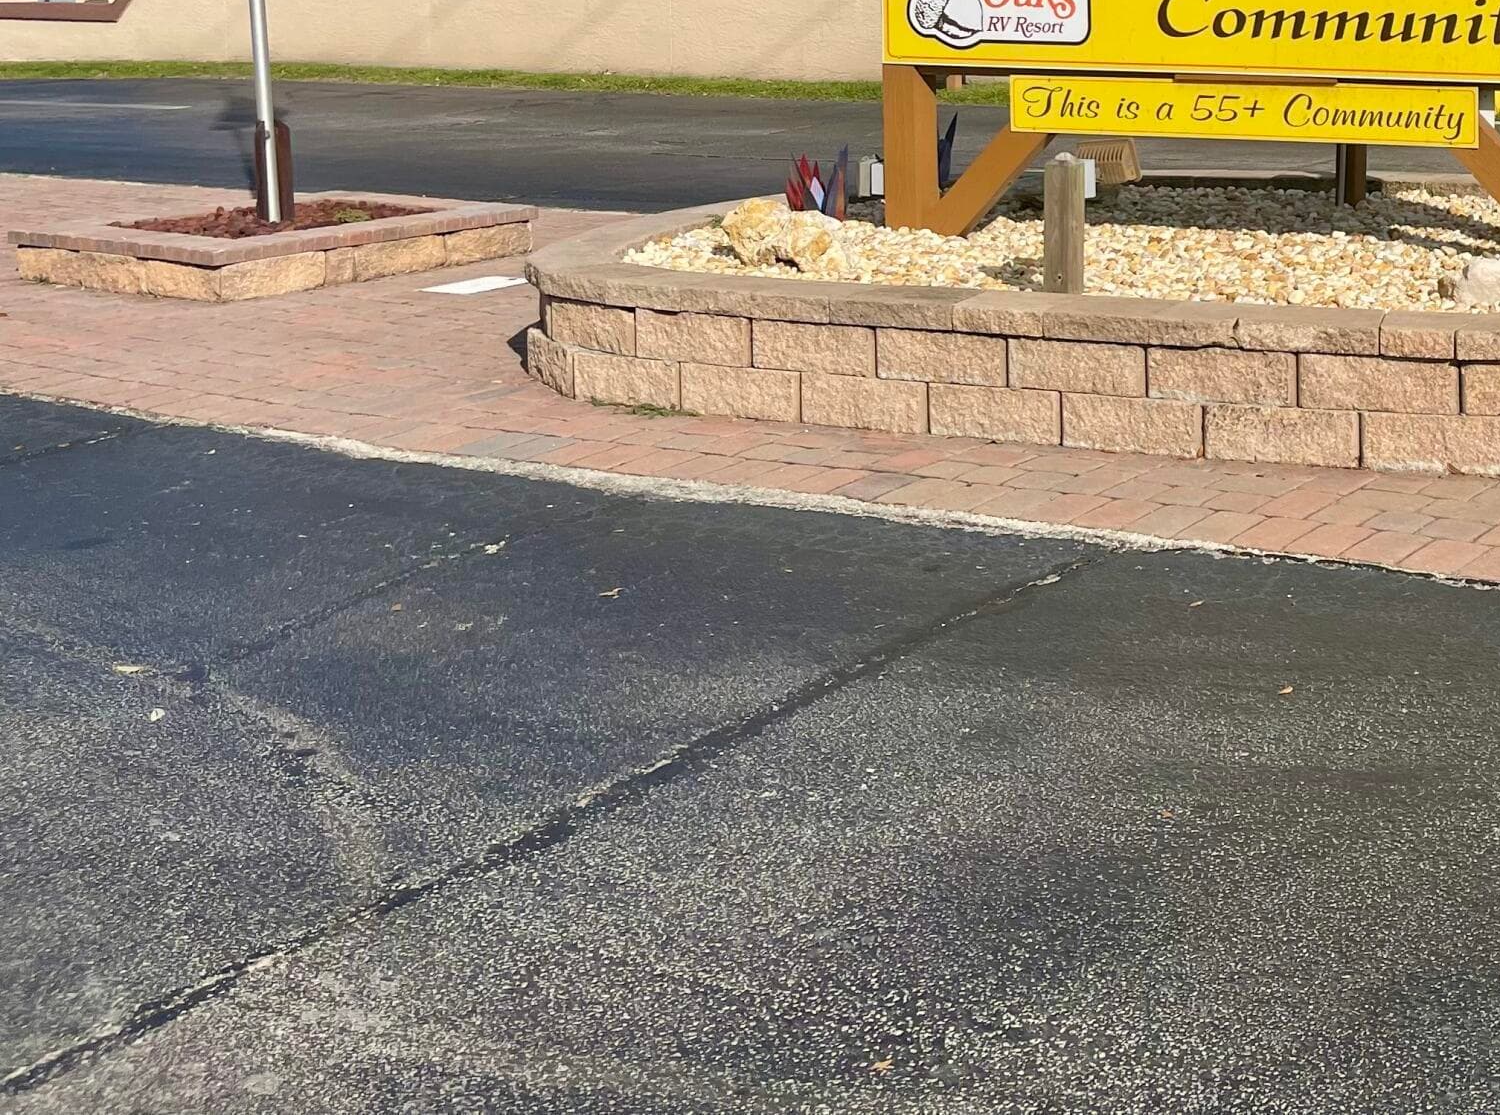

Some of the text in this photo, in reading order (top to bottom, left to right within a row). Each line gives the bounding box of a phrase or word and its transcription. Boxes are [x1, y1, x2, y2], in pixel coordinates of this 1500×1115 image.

[987, 17, 1064, 38] RV Resort
[1022, 86, 1464, 140] This is a 55+ Community
